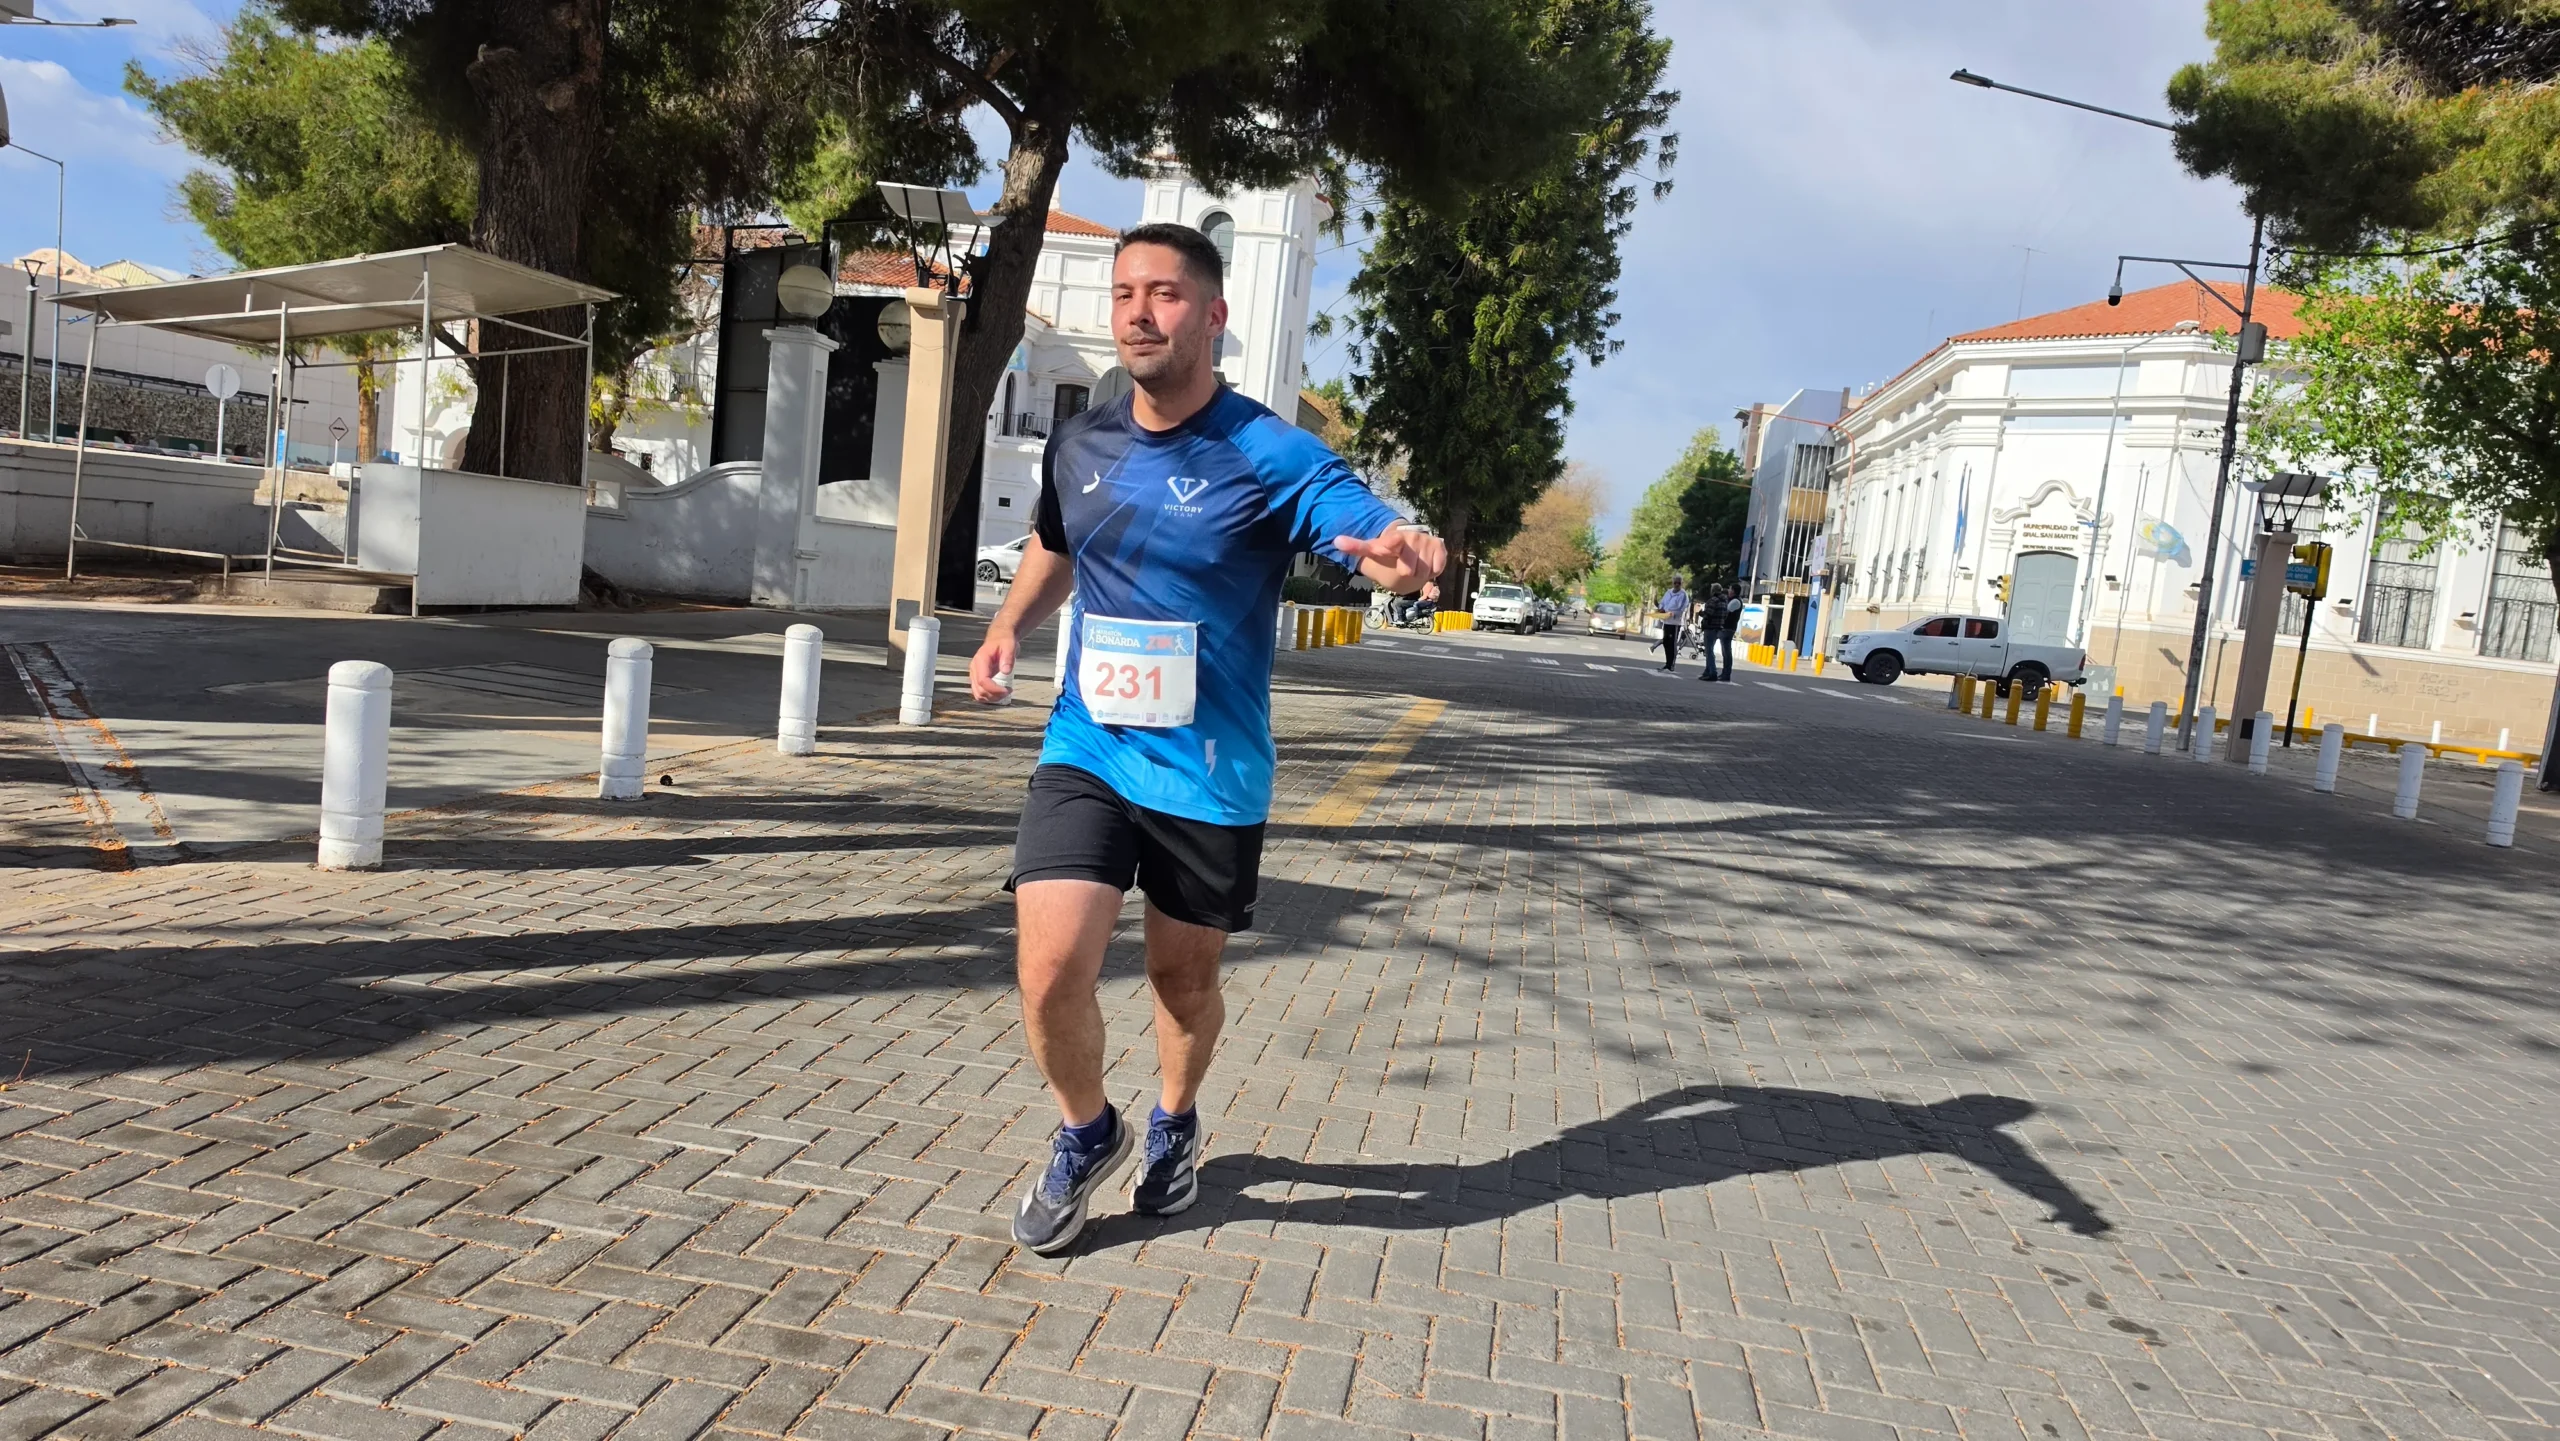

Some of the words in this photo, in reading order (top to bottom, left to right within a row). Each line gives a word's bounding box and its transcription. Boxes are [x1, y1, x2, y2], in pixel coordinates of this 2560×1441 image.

[1164, 504, 1203, 513] VICTORY
[2023, 523, 2068, 531] MUNICIPALIDAD
[1096, 636, 1140, 647] BONARDA
[1095, 662, 1161, 700] 231
